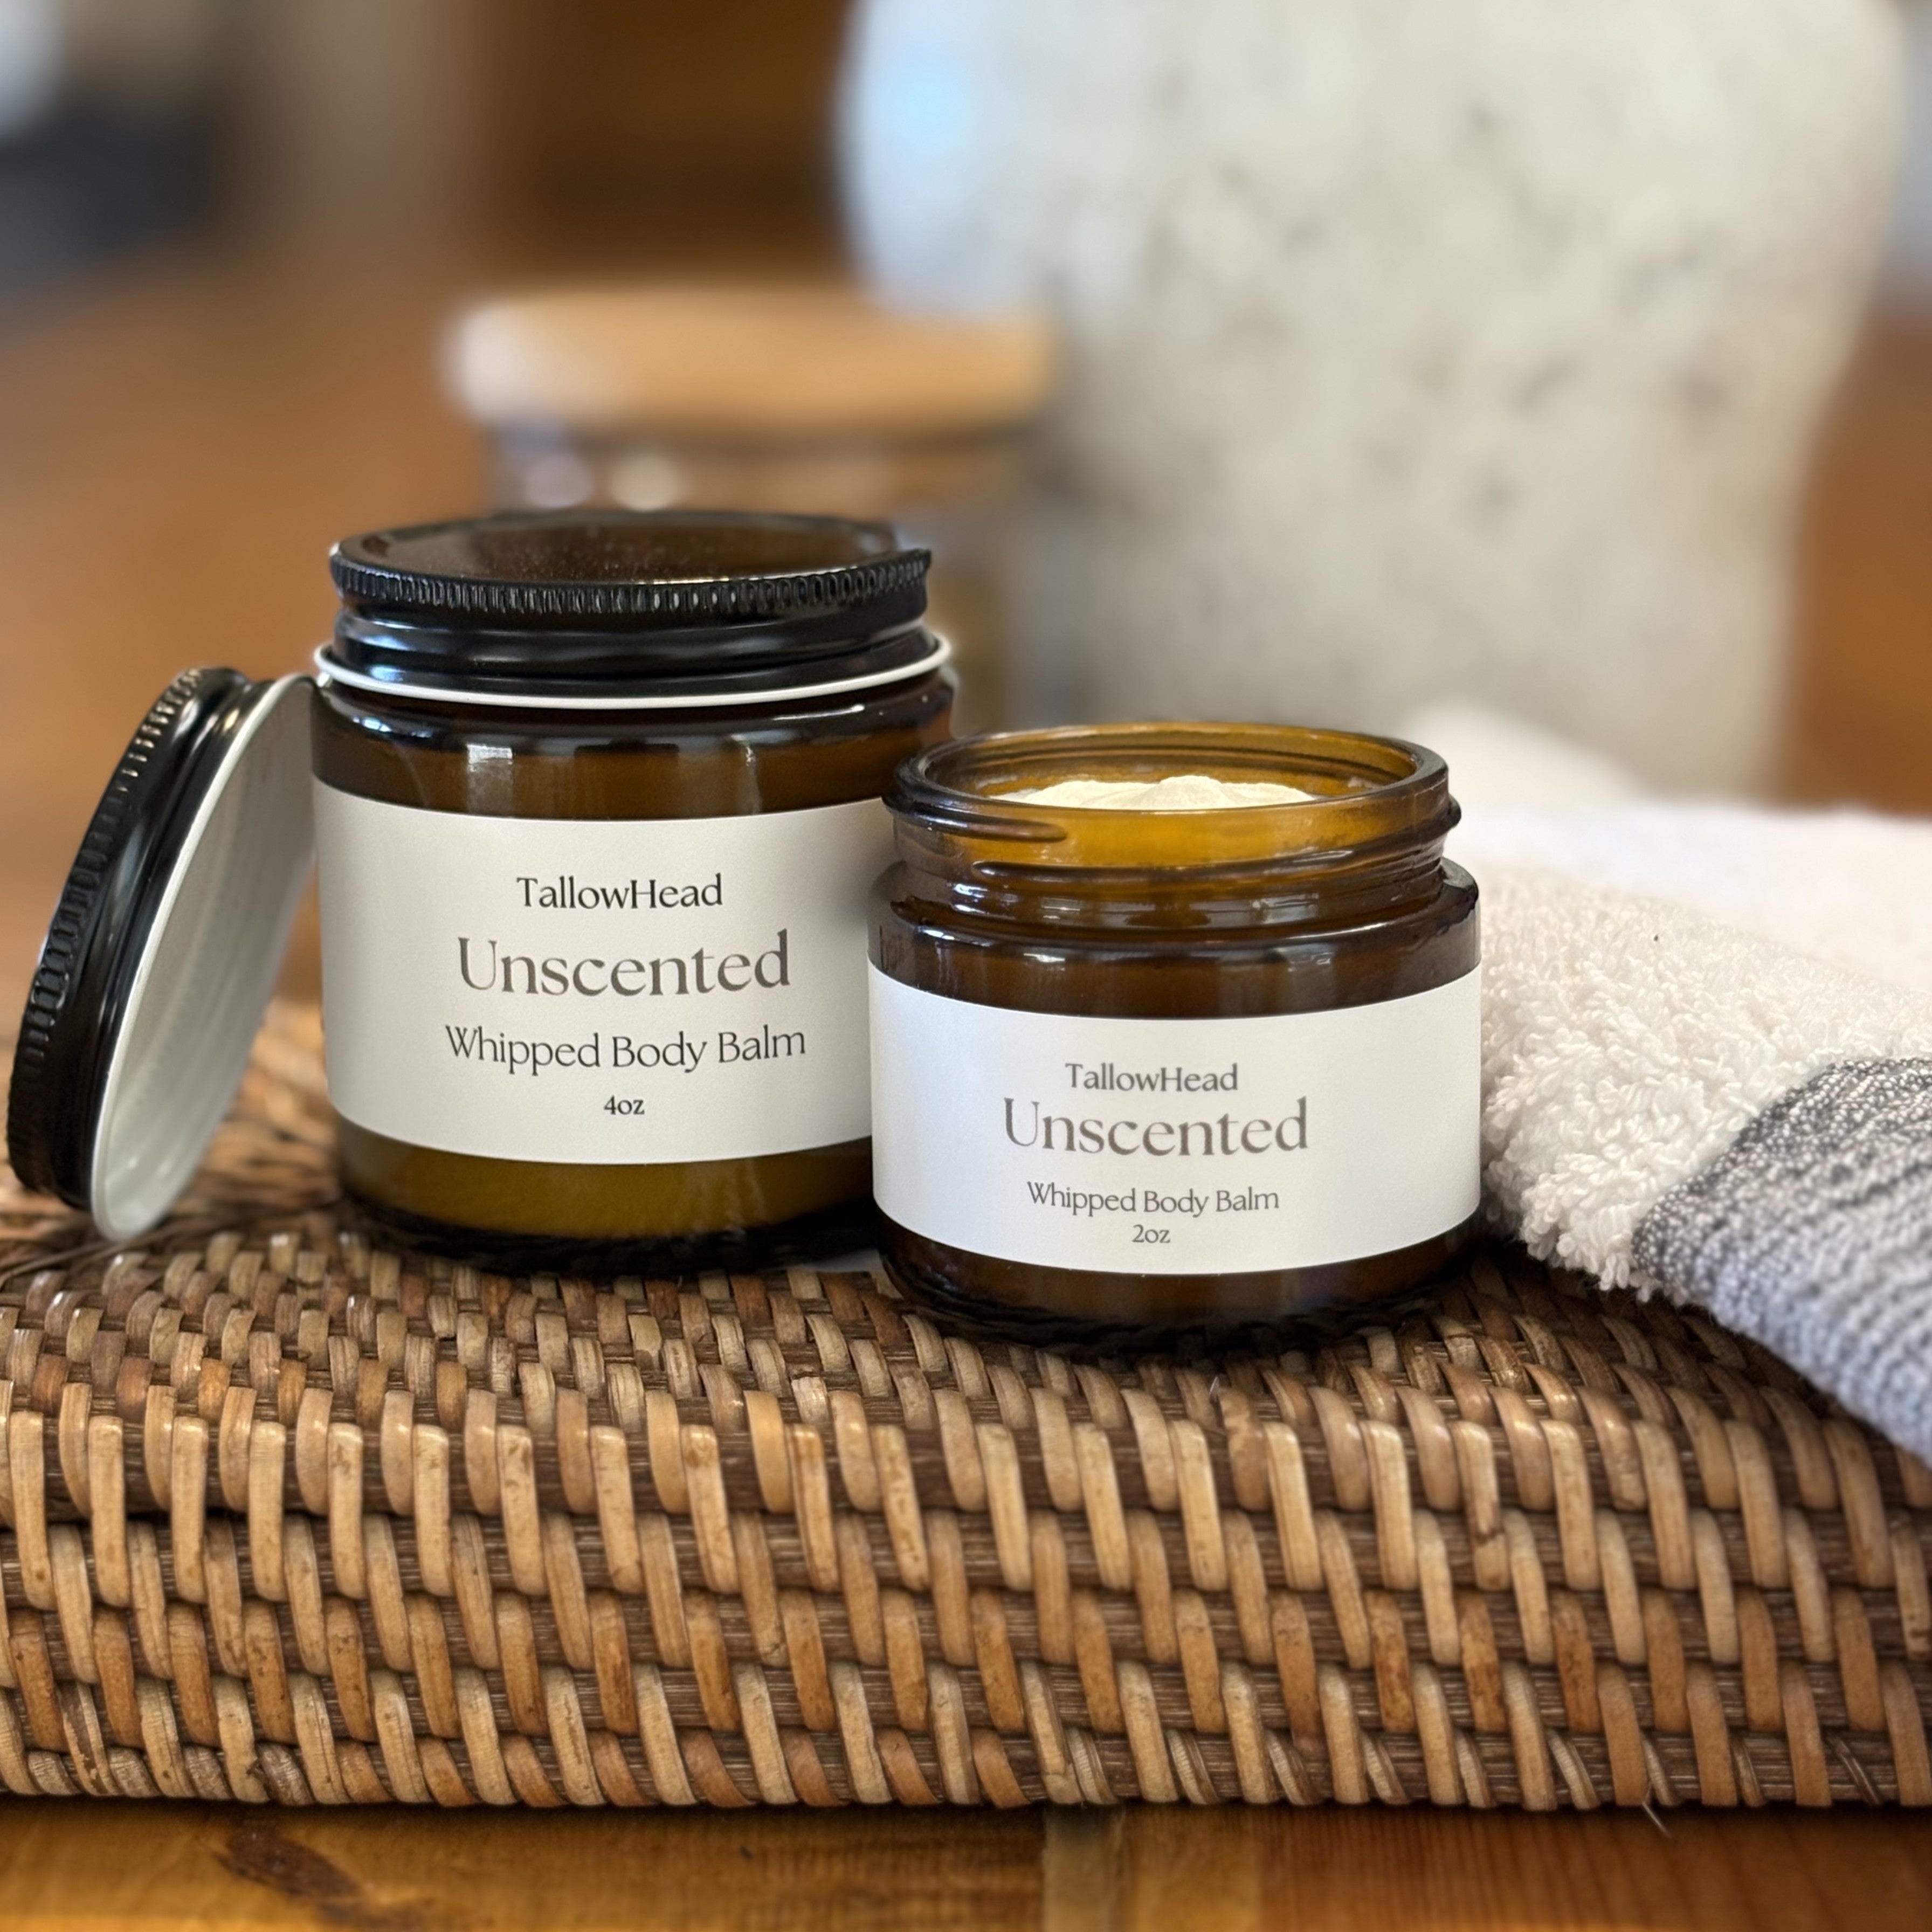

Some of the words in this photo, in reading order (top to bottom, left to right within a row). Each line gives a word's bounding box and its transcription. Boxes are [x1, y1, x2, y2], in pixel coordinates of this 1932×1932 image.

[516, 872, 723, 910] TallowHead
[458, 928, 790, 997] Unscented
[445, 1024, 601, 1077] Whipped
[612, 1031, 708, 1074] Body
[717, 1024, 806, 1064] Balm
[1065, 1062, 1238, 1092] TallowHead
[603, 1095, 645, 1115] 4oz
[1004, 1096, 1308, 1157] Unscented
[1026, 1181, 1137, 1218] Whipped
[1143, 1188, 1210, 1218] Body
[1216, 1185, 1280, 1212] Balm
[1131, 1224, 1171, 1244] 2oz
